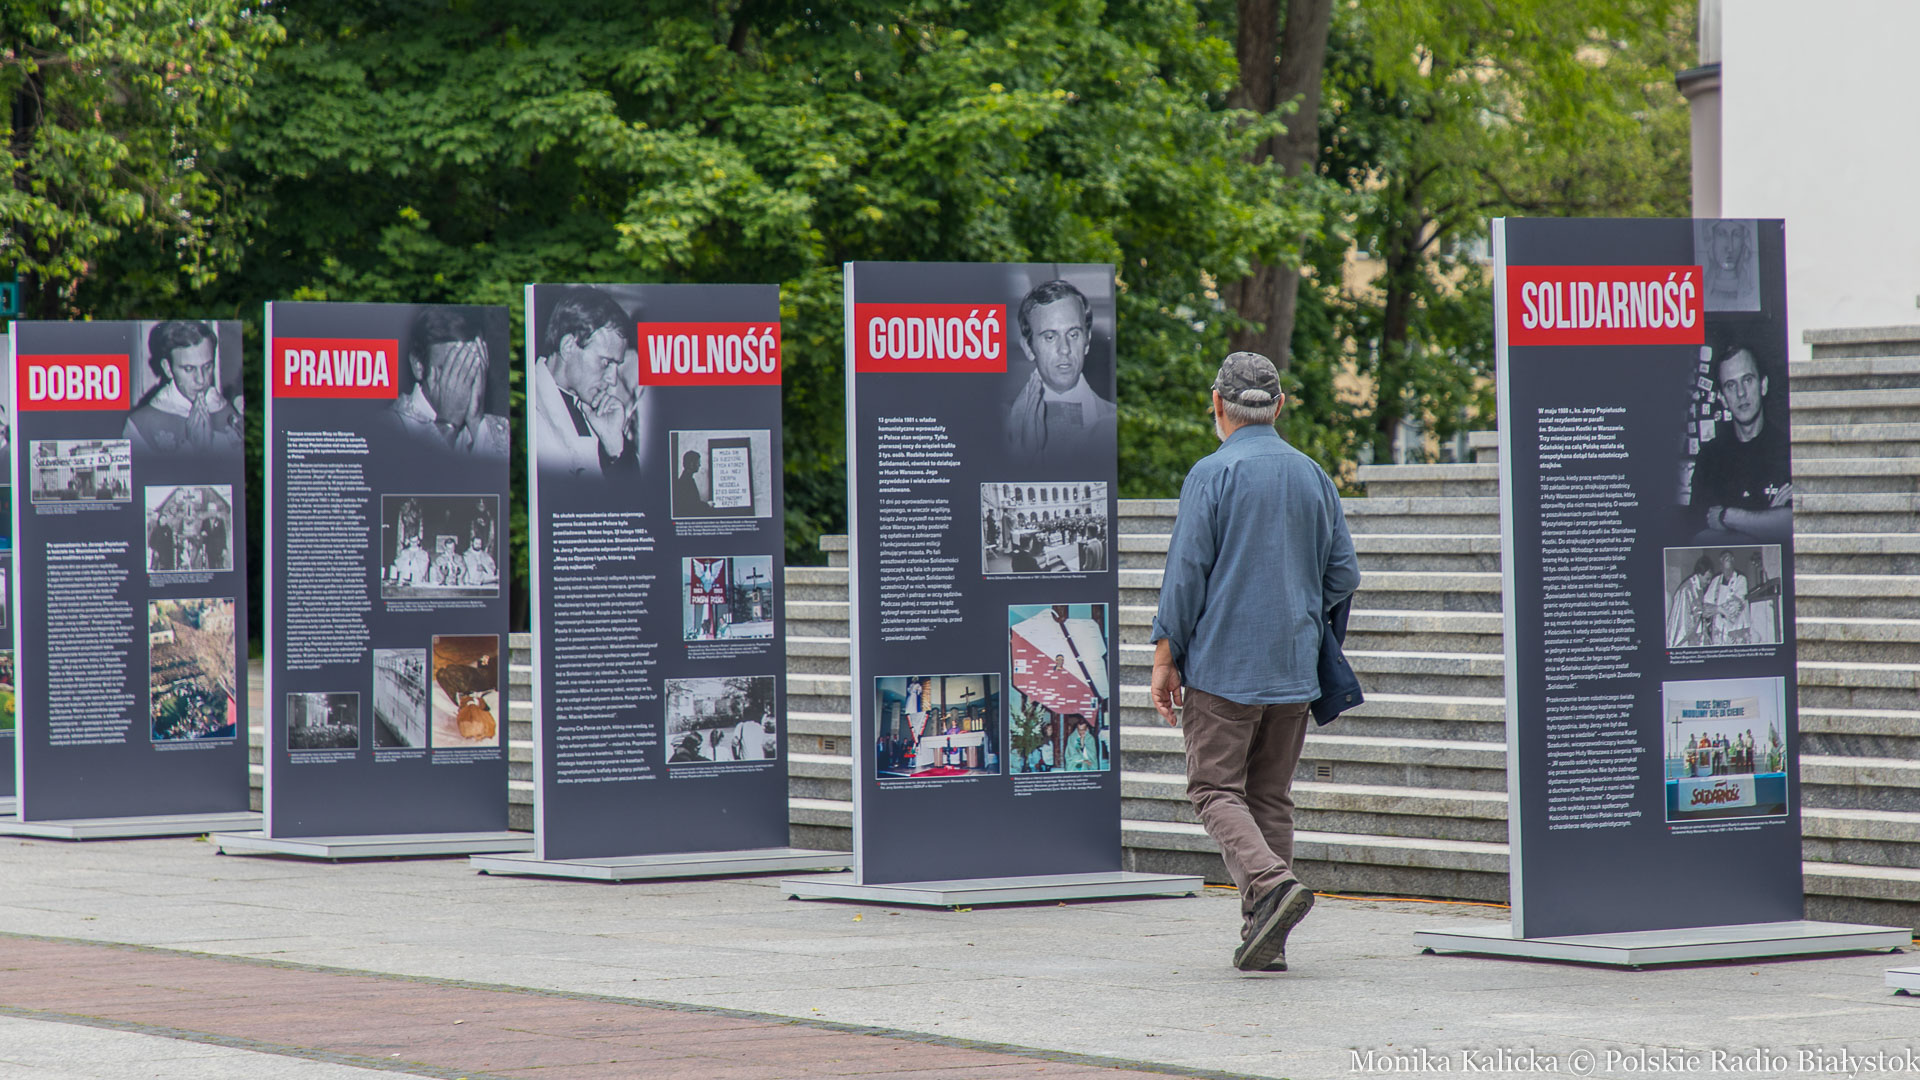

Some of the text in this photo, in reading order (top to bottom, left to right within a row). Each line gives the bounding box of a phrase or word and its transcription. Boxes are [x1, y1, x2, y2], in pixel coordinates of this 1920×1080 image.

[1522, 272, 1696, 329] SOLIDARNOŚĆ
[648, 327, 776, 374] WOLNOŚĆ
[869, 310, 1000, 360] GODNOŚĆ
[29, 364, 120, 400] DOBRO
[284, 350, 390, 387] PRAWDA
